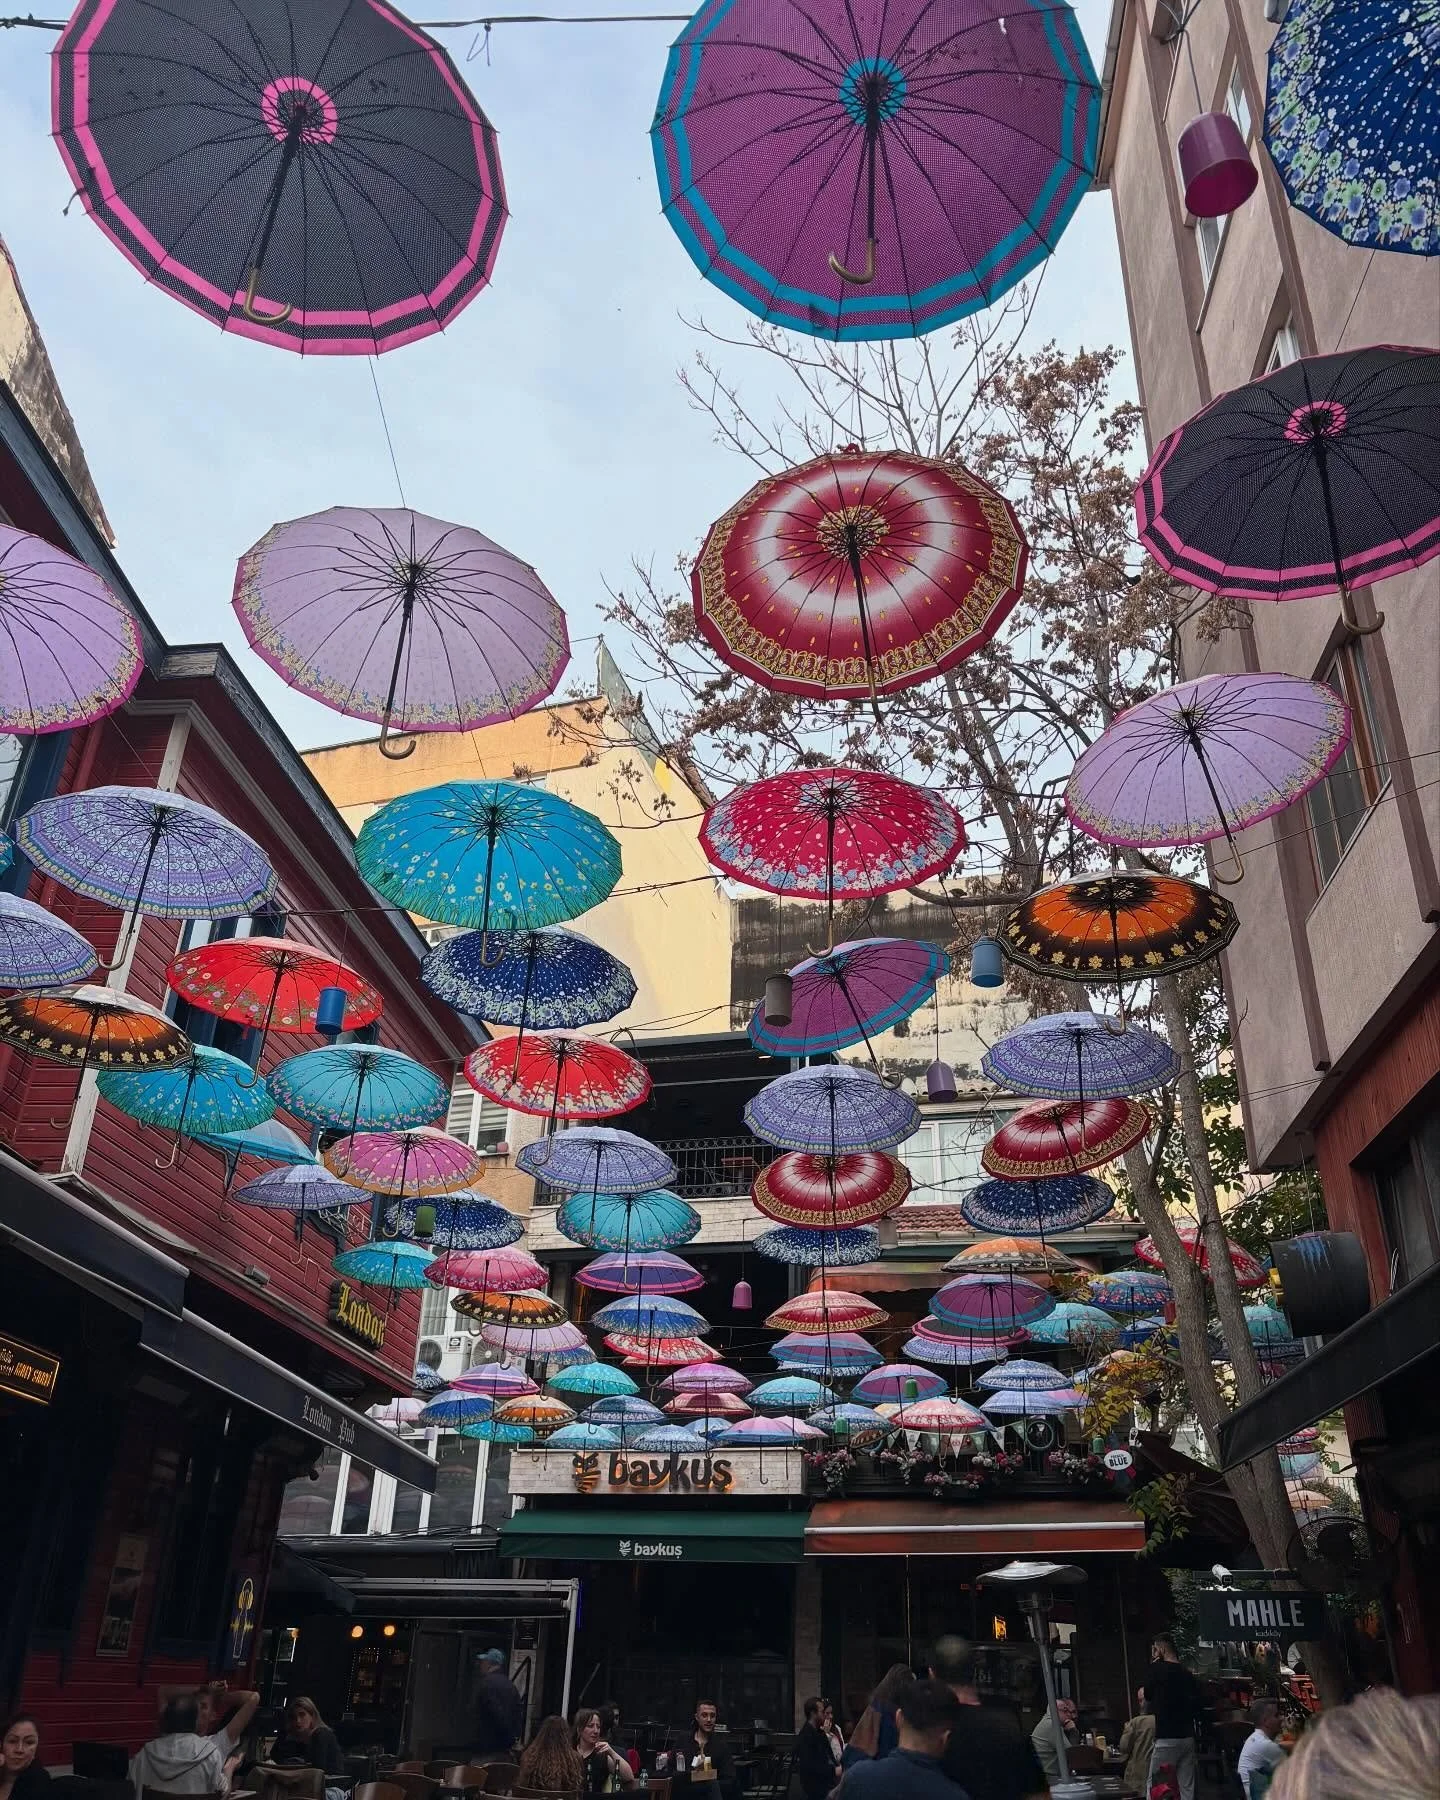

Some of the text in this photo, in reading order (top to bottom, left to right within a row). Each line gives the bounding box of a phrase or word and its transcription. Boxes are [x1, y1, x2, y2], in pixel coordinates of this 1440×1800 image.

[338, 1282, 385, 1346] London
[302, 1395, 332, 1432] London
[608, 1451, 733, 1491] baykuş
[1109, 1457, 1128, 1467] BLUE
[633, 1542, 683, 1559] baykuş
[1226, 1599, 1305, 1627] MAHLE
